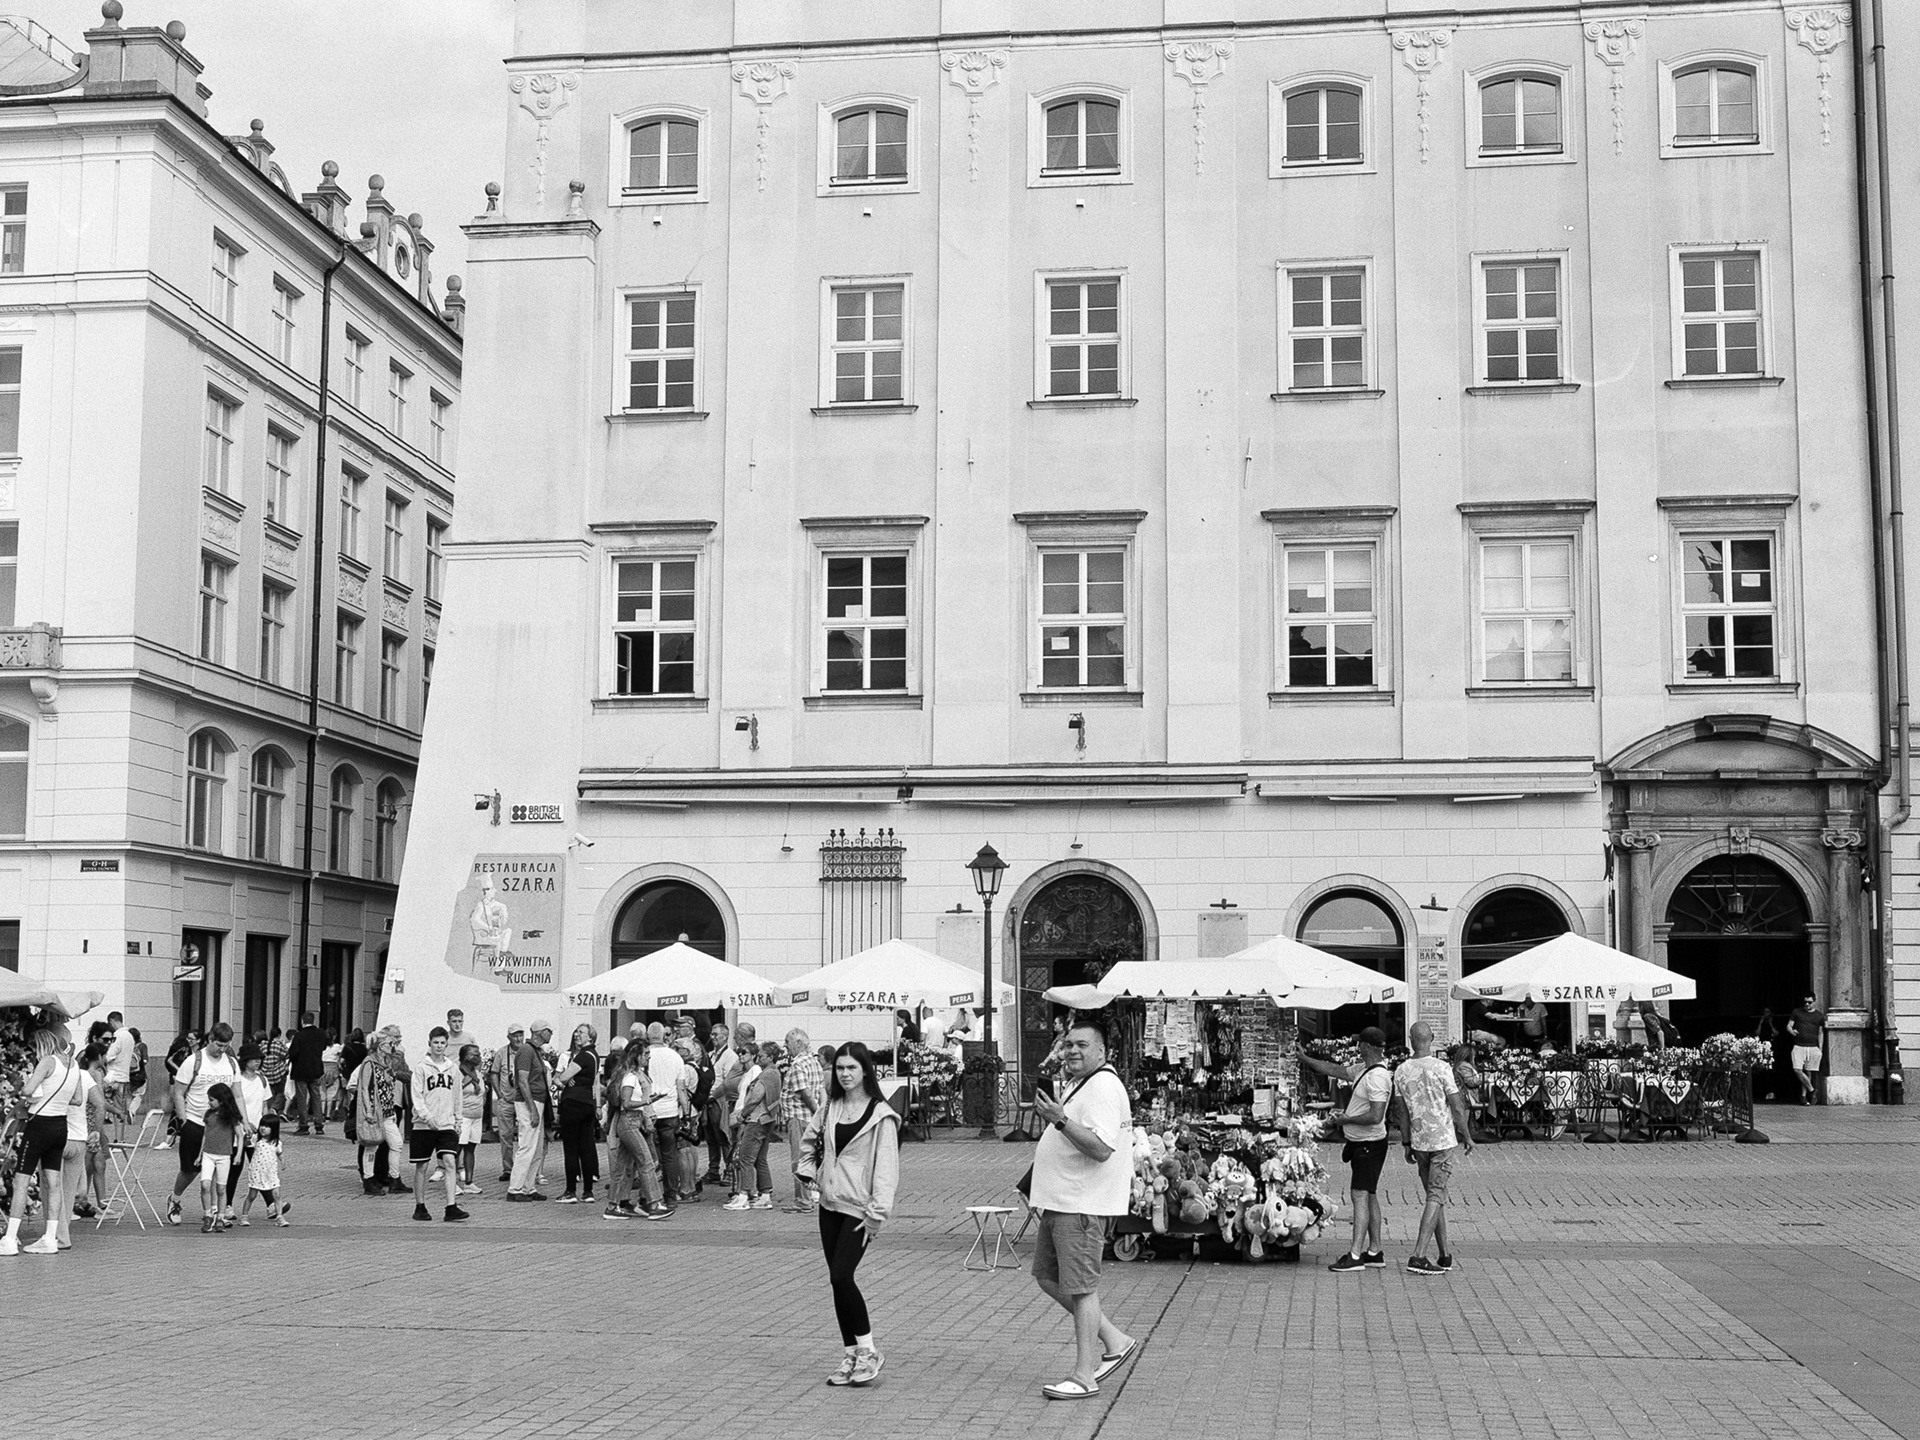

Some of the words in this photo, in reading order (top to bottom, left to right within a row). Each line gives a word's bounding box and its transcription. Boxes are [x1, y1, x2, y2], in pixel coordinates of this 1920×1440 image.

[529, 805, 560, 813] BRITISH
[528, 812, 562, 820] COUNCIL
[474, 862, 556, 873] RESTAURACJA
[502, 877, 555, 892] SZARA
[488, 956, 552, 967] WYKWINTNA
[1420, 952, 1436, 960] BAR
[506, 972, 551, 984] KUCHNIA
[1554, 985, 1605, 999] SZARA
[576, 993, 608, 1006] SZARA
[660, 995, 685, 1005] PERŁA
[738, 993, 773, 1006] SZARA
[849, 992, 897, 1004] SZARA
[952, 994, 972, 1004] PERŁA
[200, 1073, 232, 1083] ESPRIT
[426, 1073, 454, 1091] GAP
